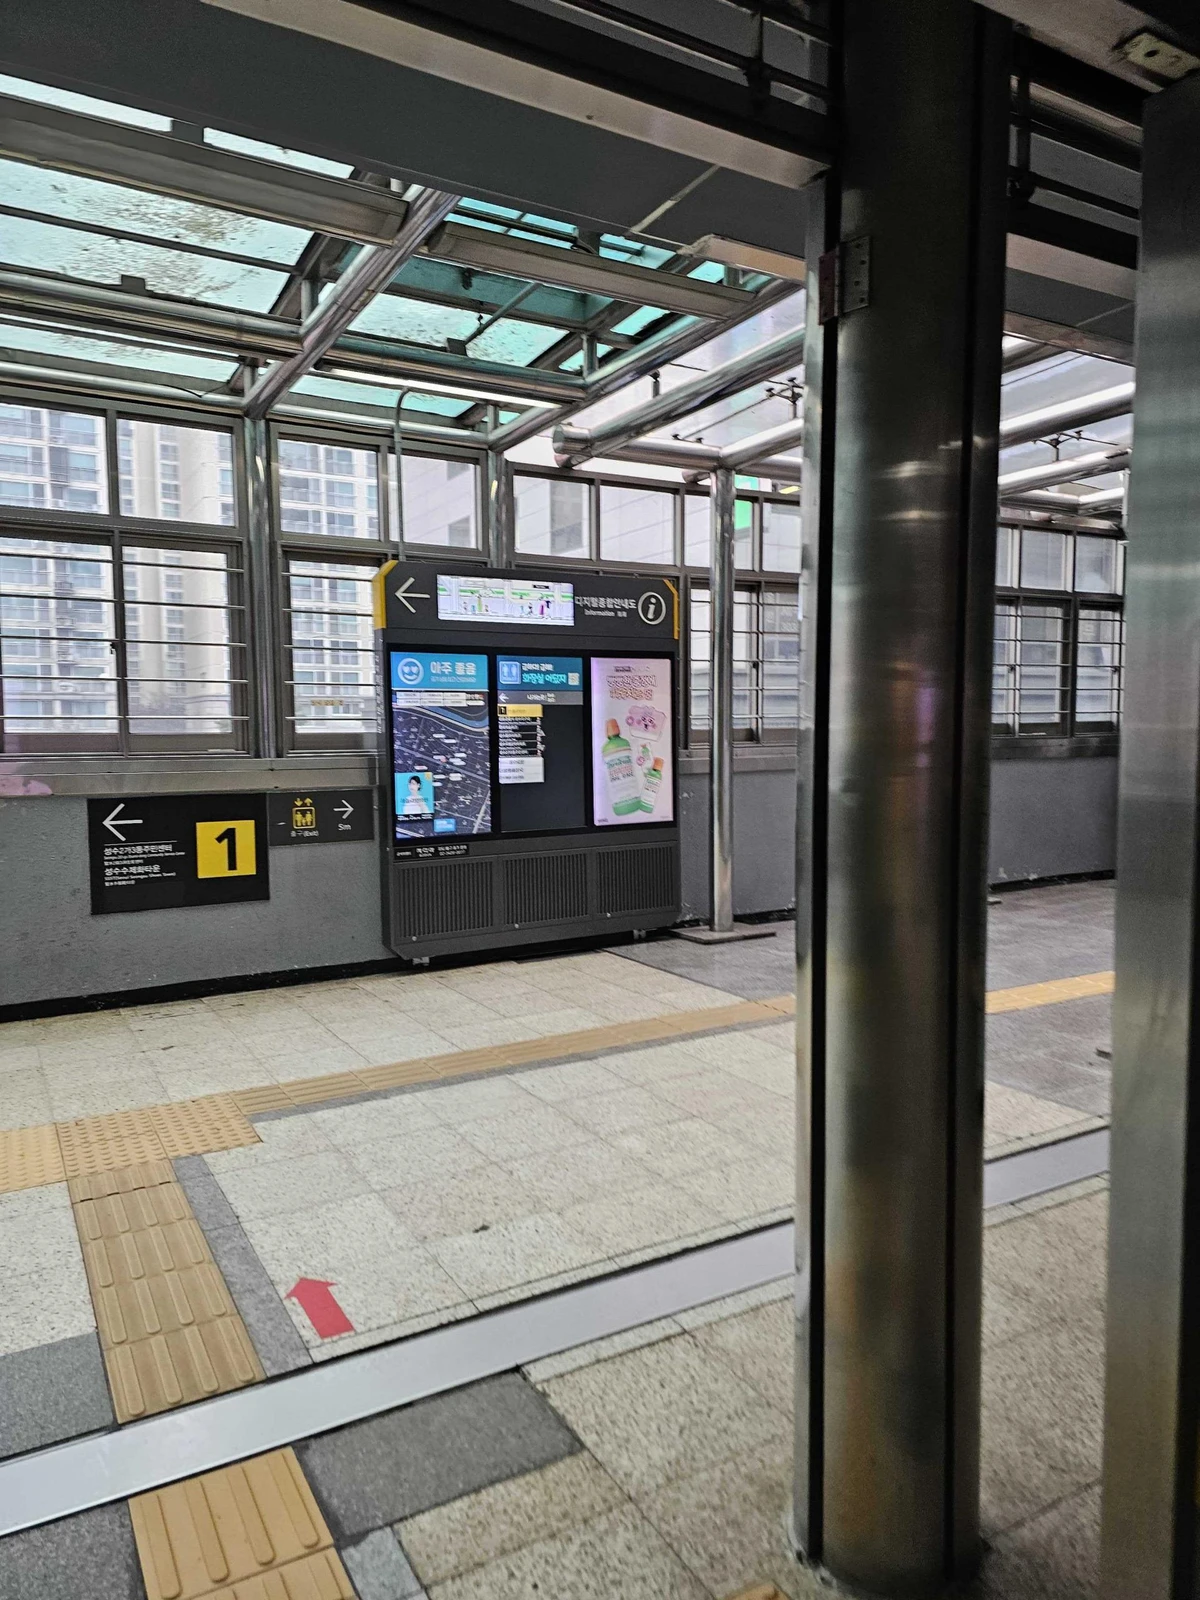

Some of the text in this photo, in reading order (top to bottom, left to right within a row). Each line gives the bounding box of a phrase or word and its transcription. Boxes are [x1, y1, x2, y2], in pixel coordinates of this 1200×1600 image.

[430, 661, 477, 675] 아주 좋음
[215, 827, 238, 871] 1
[104, 864, 161, 876] 성수수제화타운
